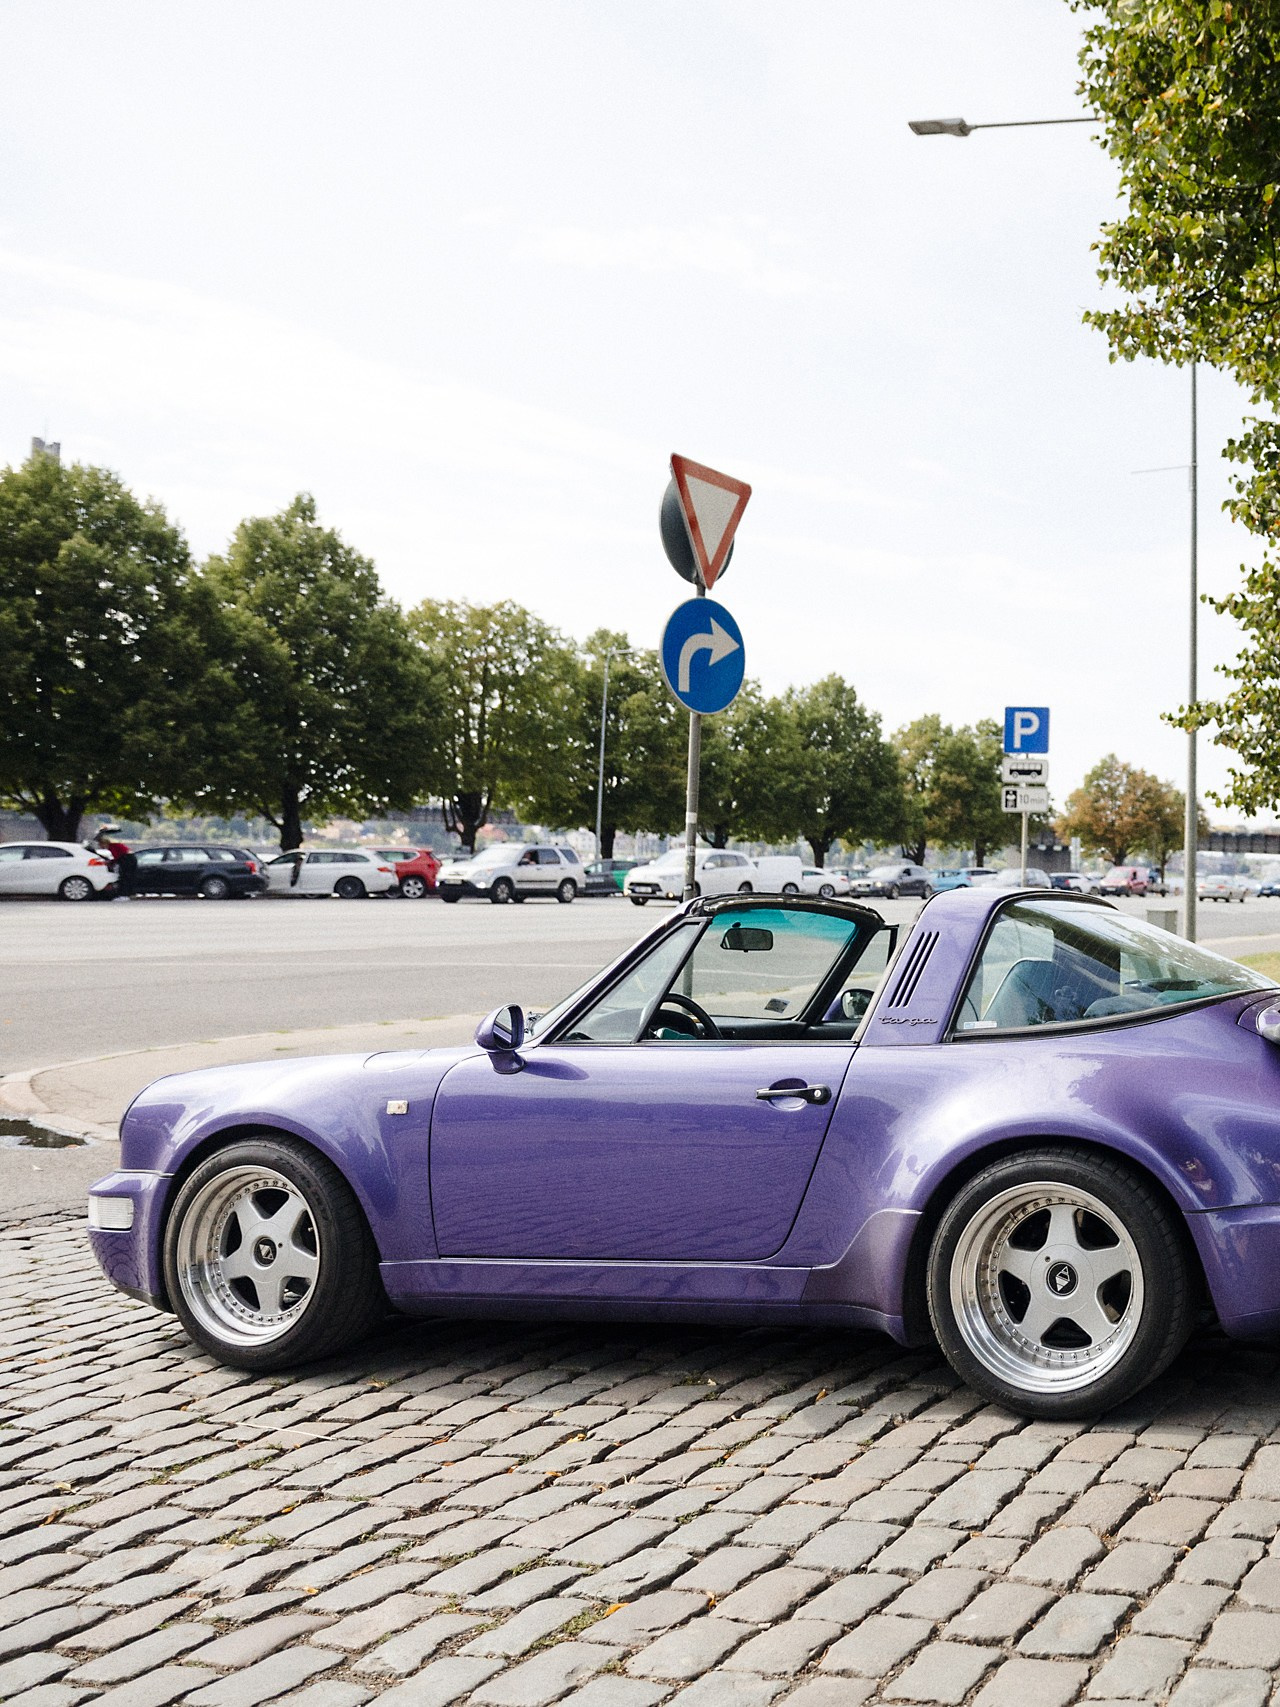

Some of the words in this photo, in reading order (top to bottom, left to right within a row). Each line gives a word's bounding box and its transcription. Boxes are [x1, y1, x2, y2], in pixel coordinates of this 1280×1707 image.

[1013, 711, 1040, 749] P
[1019, 794, 1029, 804] 10
[1030, 796, 1045, 804] min
